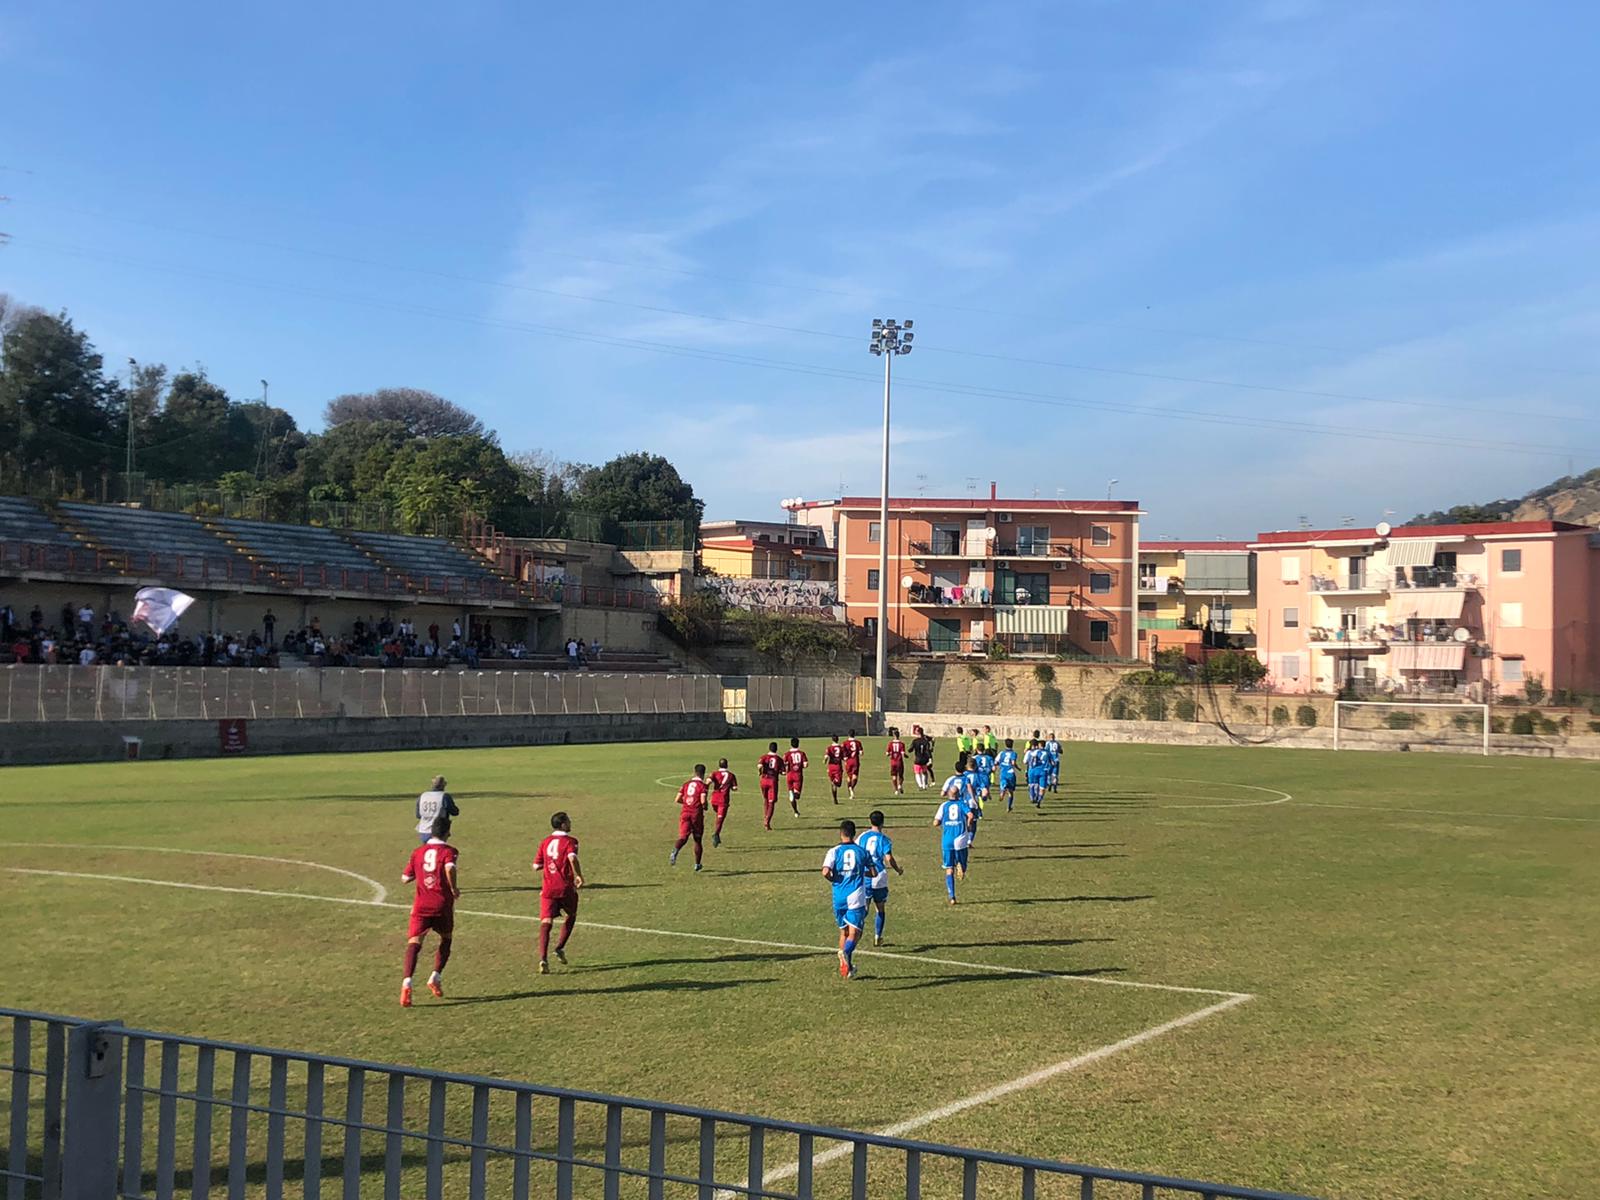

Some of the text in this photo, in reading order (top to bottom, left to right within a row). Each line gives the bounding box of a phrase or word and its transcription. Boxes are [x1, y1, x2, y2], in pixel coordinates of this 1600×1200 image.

[790, 752, 801, 763] 10
[720, 772, 729, 788] 7
[687, 781, 698, 796] 6
[423, 801, 438, 813] 313
[948, 803, 958, 820] 8
[546, 838, 560, 860] 4
[423, 848, 438, 872] 9
[843, 849, 856, 871] 9
